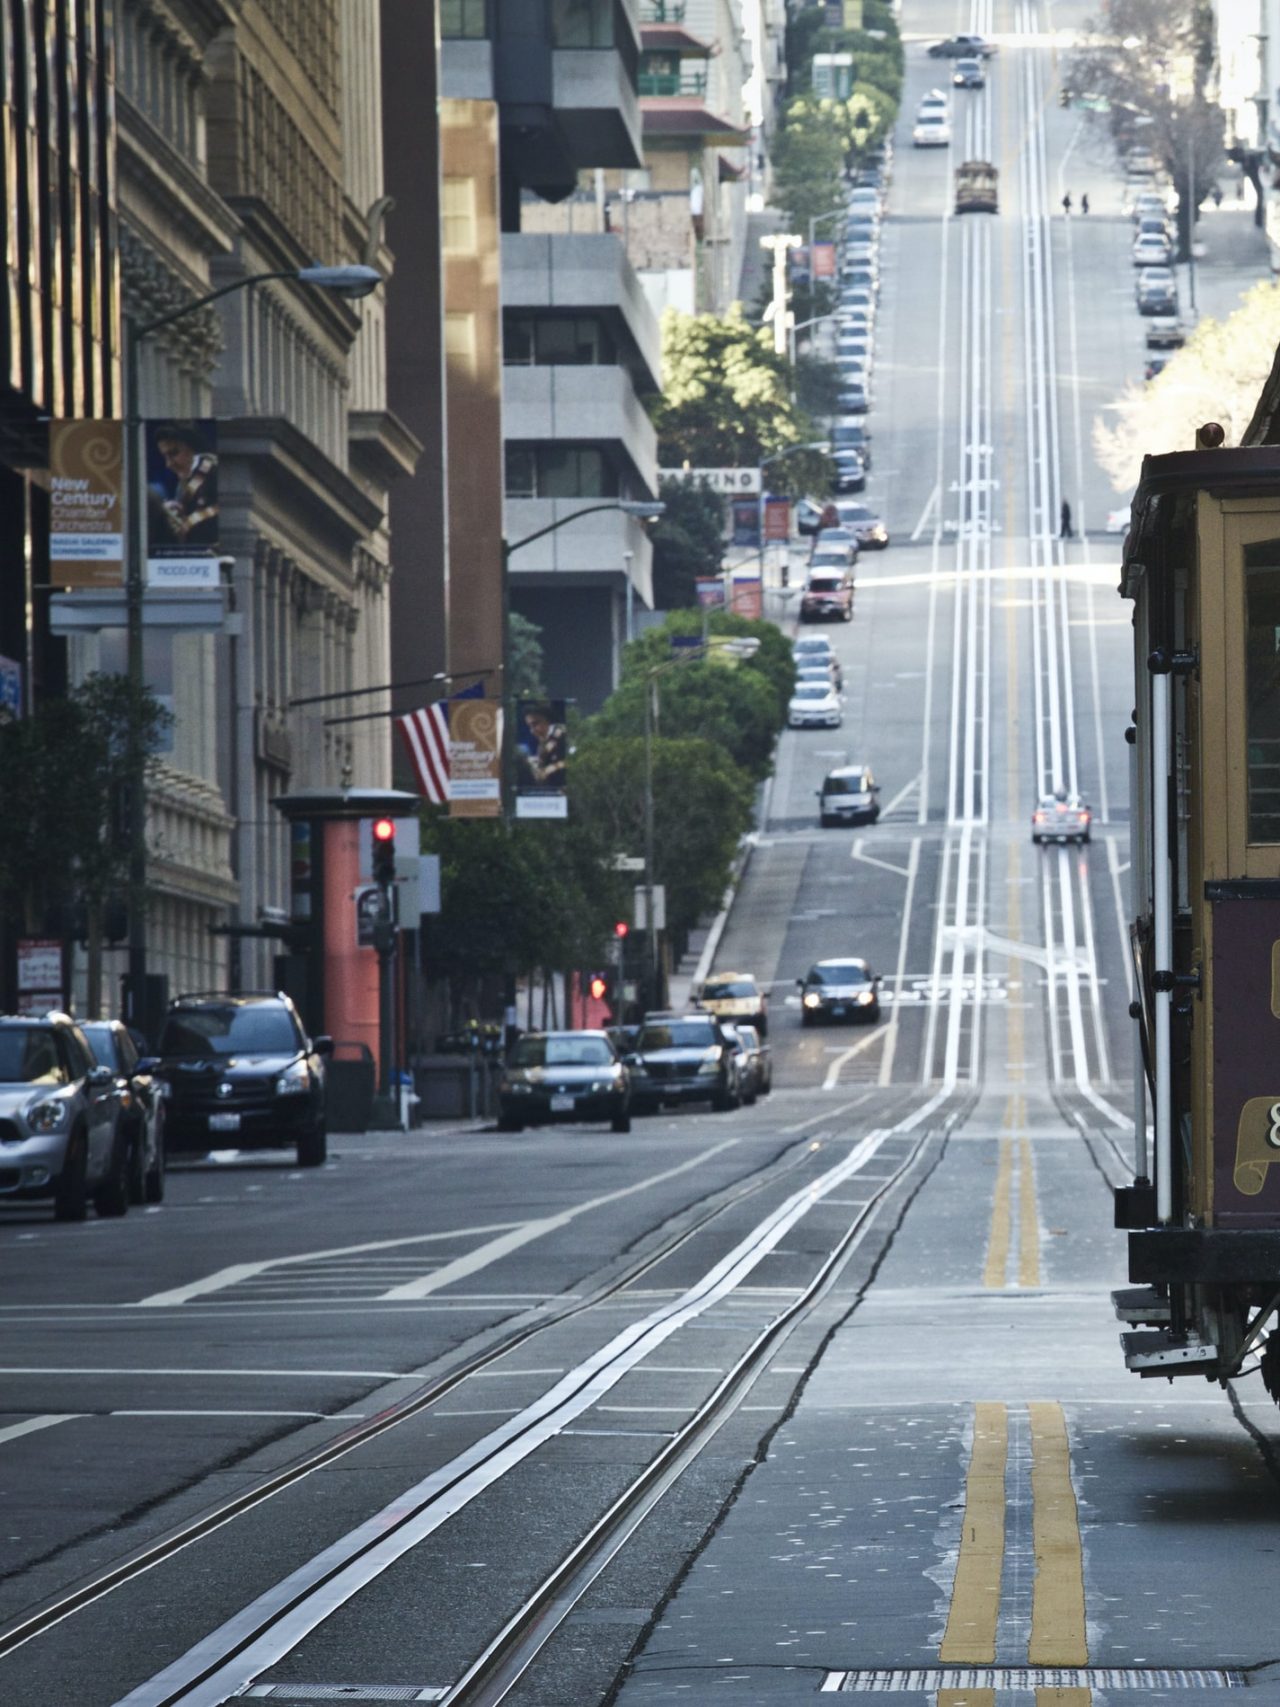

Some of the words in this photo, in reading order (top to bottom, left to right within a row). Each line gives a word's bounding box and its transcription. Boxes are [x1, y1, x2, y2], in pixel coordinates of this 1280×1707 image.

[51, 477, 90, 491] New
[51, 491, 117, 509] Century
[51, 506, 108, 519] Chamber
[51, 519, 112, 532] Orchestra
